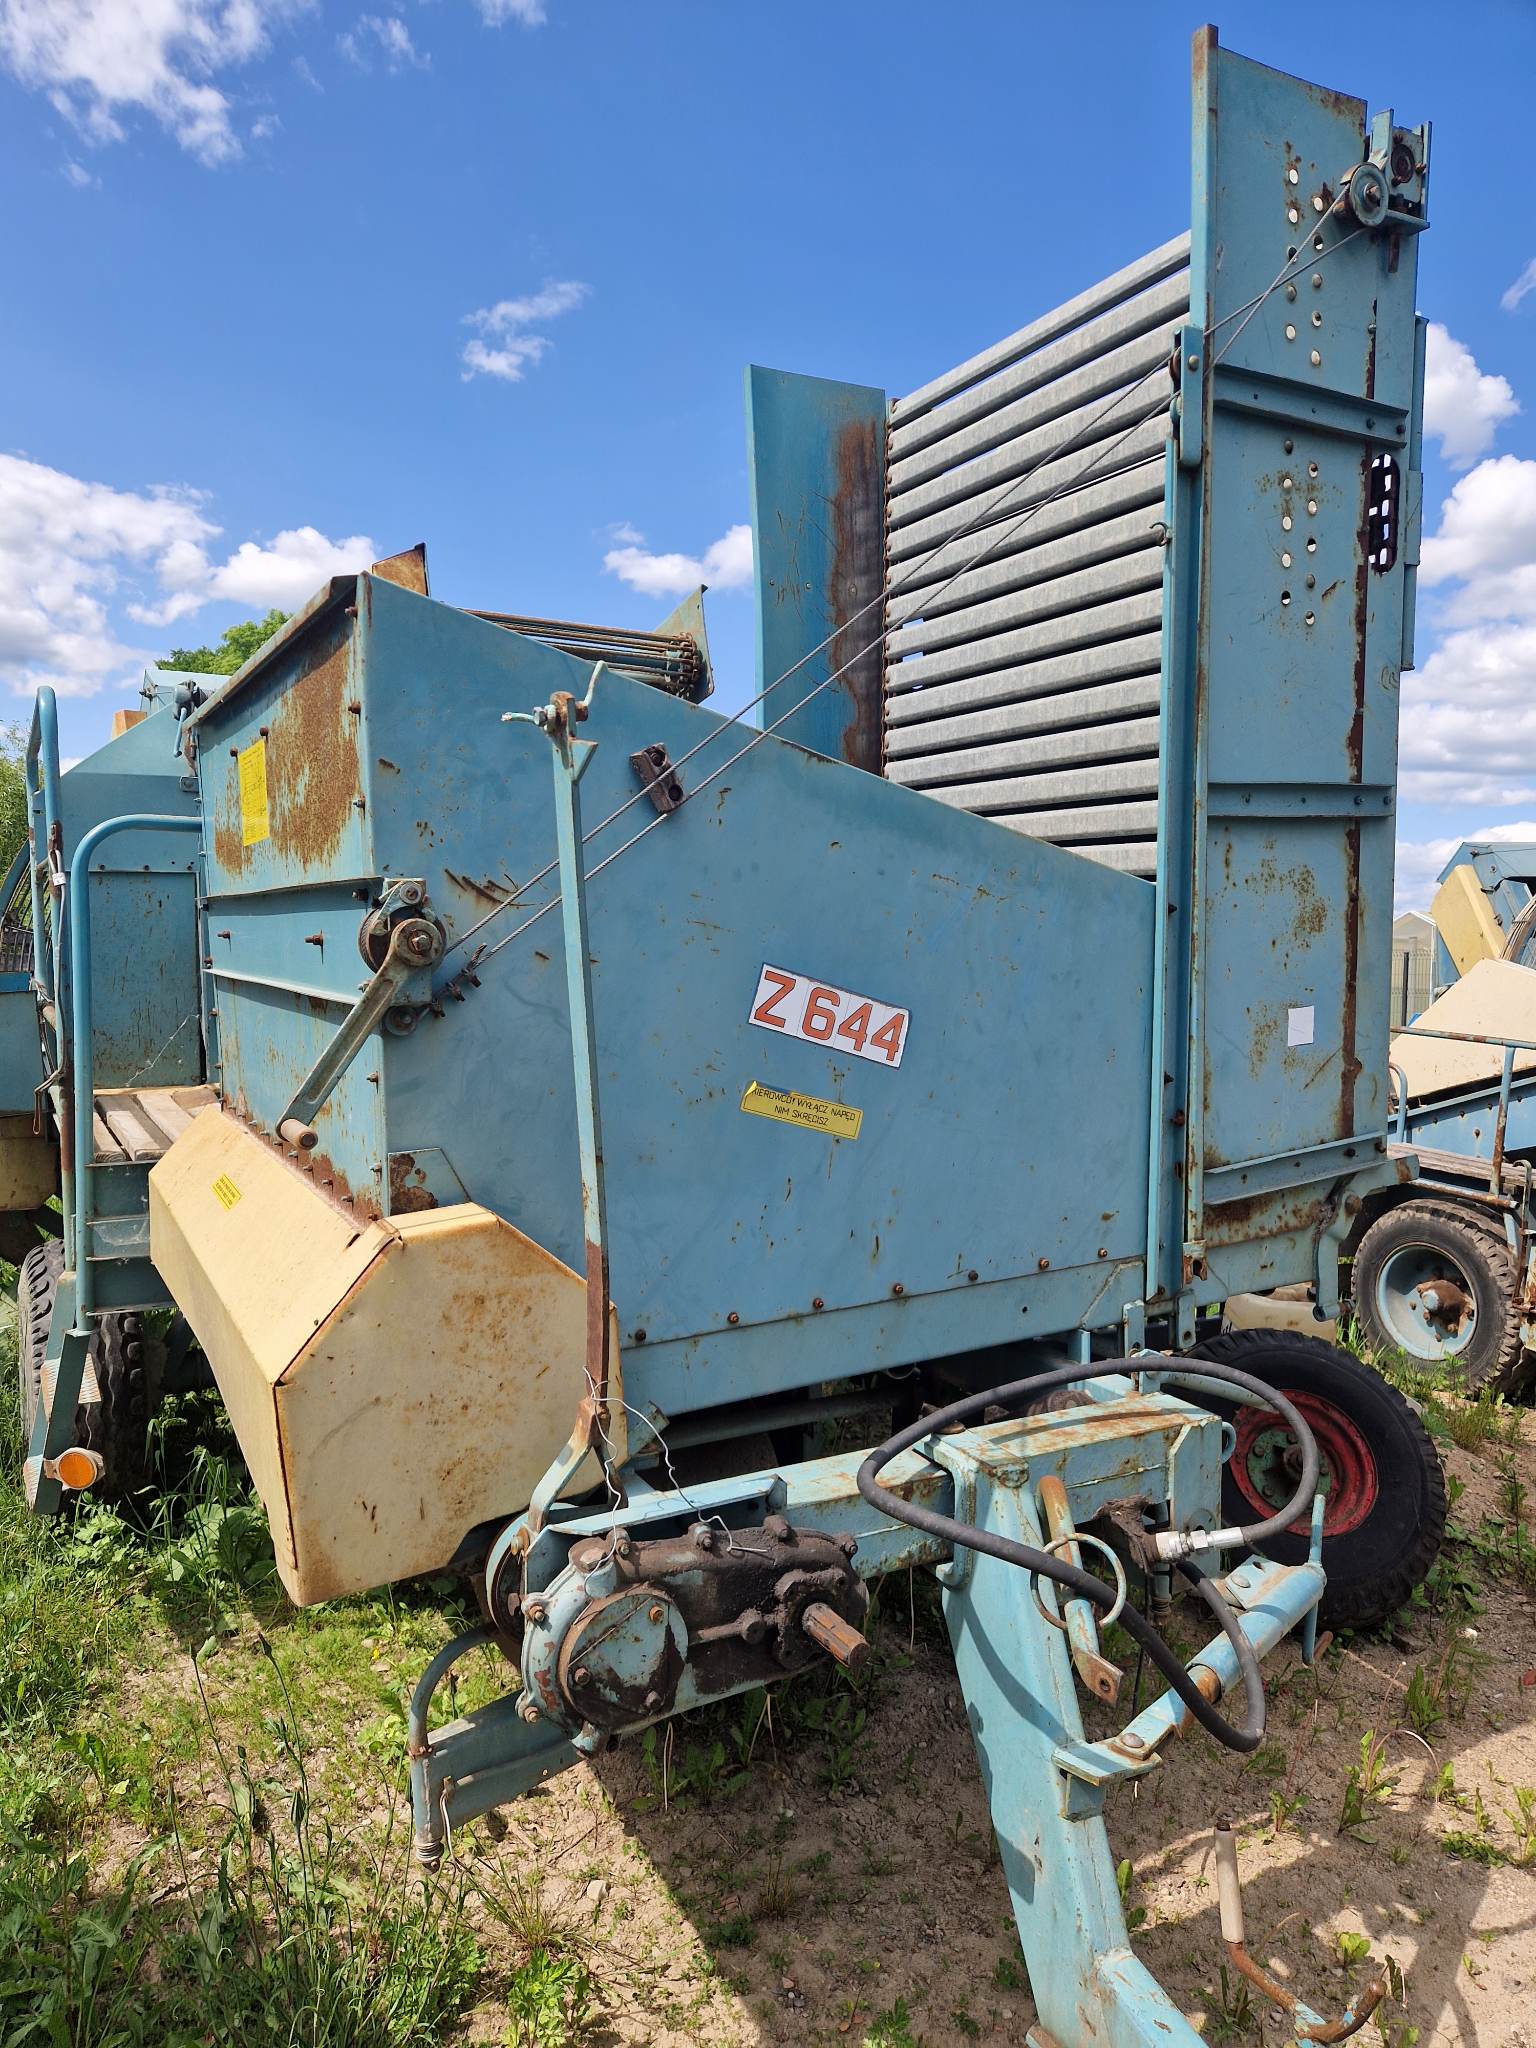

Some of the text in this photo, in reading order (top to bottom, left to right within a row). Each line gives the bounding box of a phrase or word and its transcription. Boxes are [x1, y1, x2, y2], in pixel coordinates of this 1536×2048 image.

[774, 1105, 829, 1126] NIM SKRĘCISZ
[797, 1098, 829, 1114] WYŁĄCZ
[831, 1107, 856, 1122] NAPĘD
